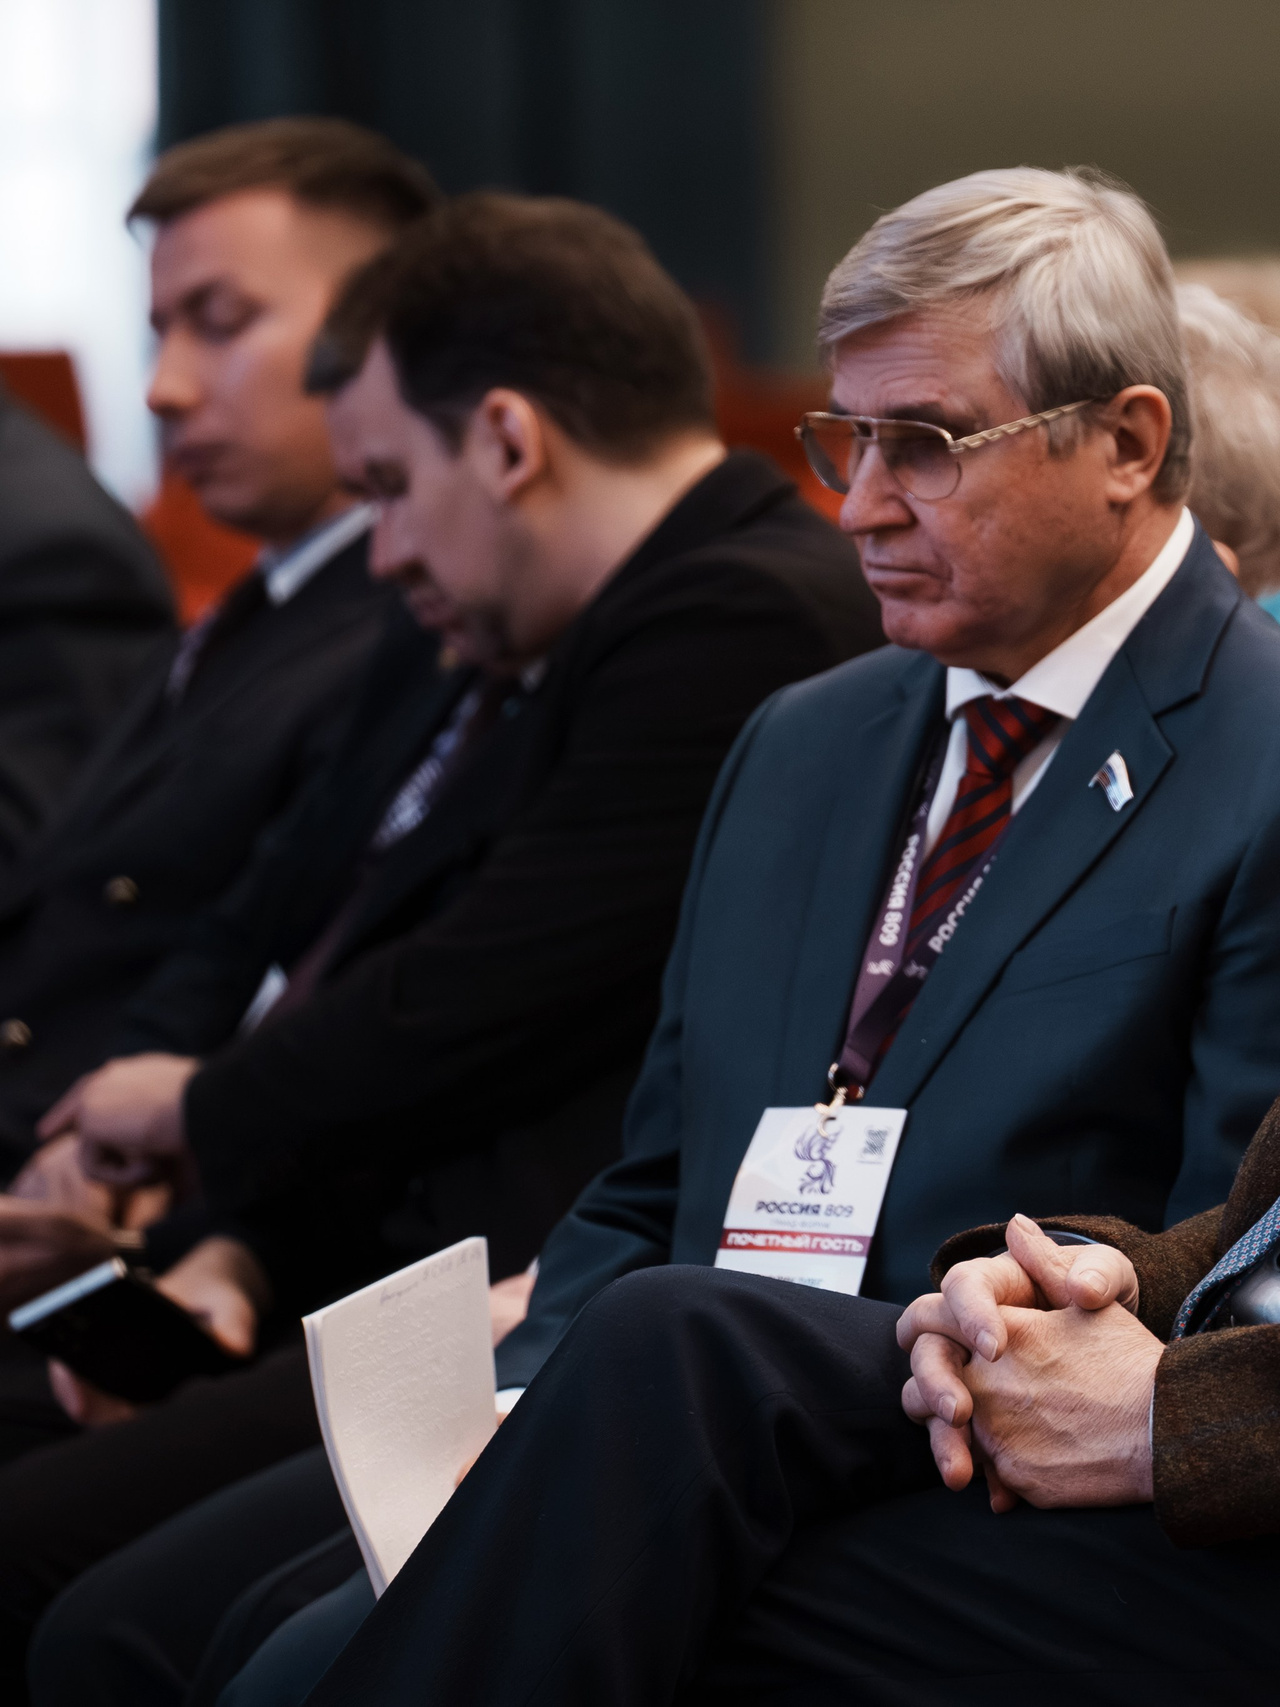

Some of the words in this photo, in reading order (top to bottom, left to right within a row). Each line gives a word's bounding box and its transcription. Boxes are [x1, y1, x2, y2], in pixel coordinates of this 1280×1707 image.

[887, 833, 920, 910] РОССИЯ
[879, 911, 903, 946] 809
[755, 1200, 821, 1216] РОССИЯ
[824, 1204, 854, 1218] 809
[811, 1236, 864, 1252] ГОСТЬ
